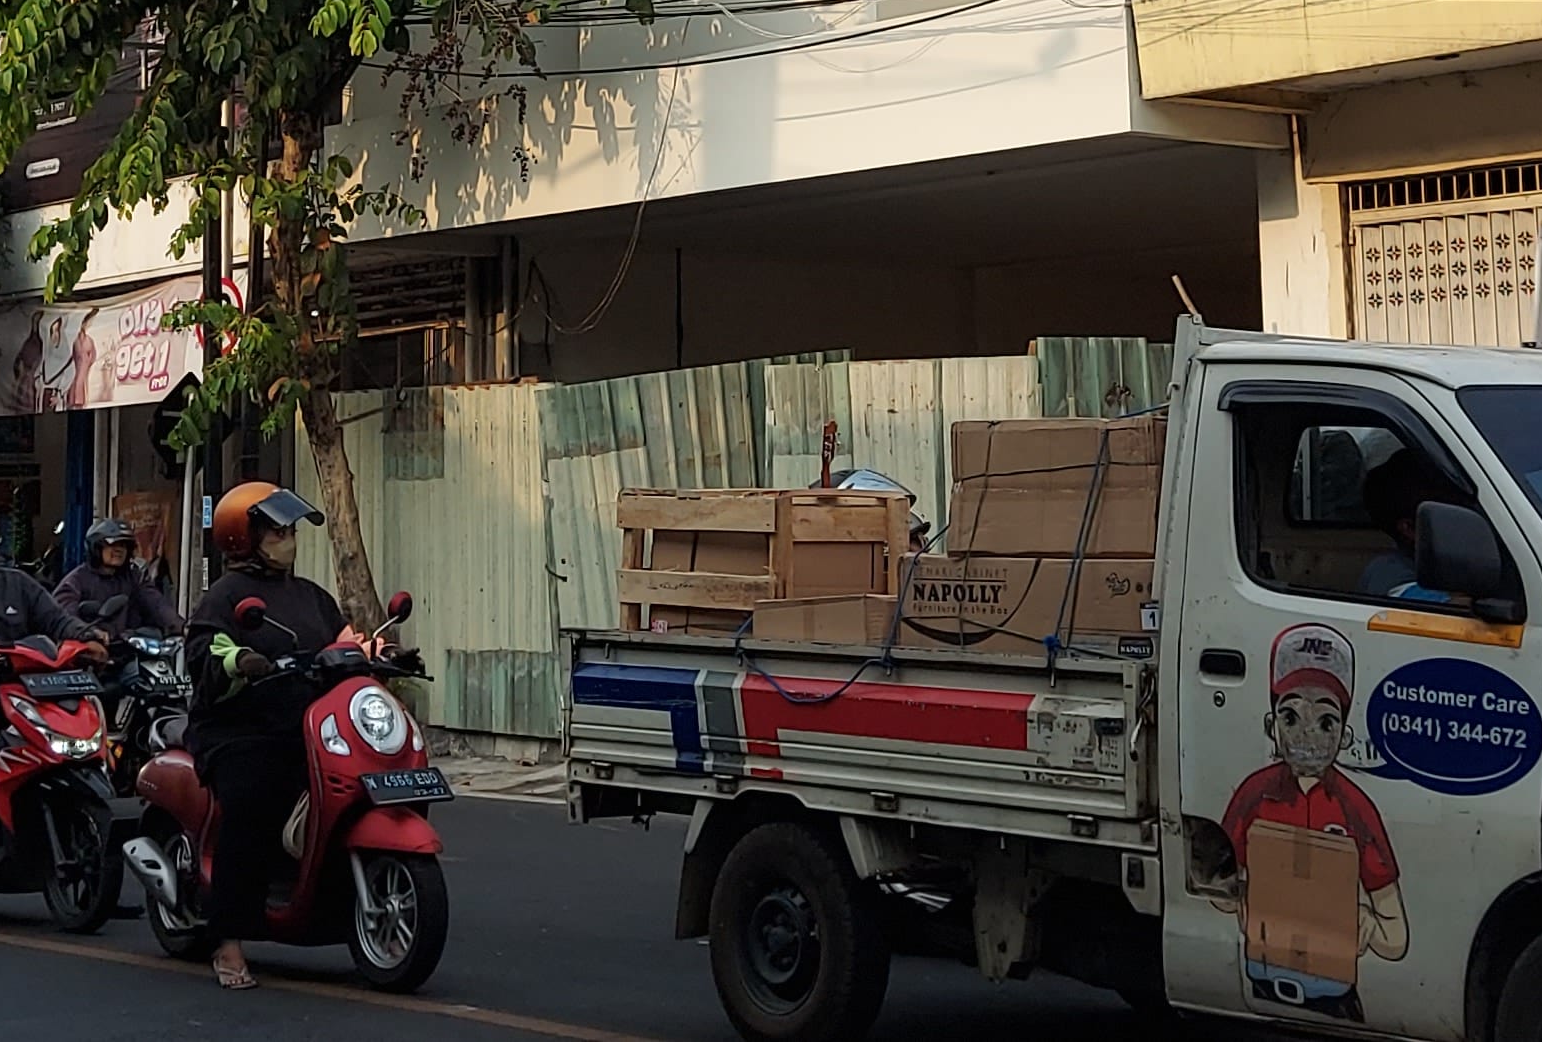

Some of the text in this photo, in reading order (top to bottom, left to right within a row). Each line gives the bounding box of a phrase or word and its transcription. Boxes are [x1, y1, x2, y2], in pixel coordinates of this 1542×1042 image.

[913, 583, 1002, 604] NAPOLLY
[1383, 680, 1530, 715] Customer Care
[1381, 712, 1527, 749] (0341) 344-672
